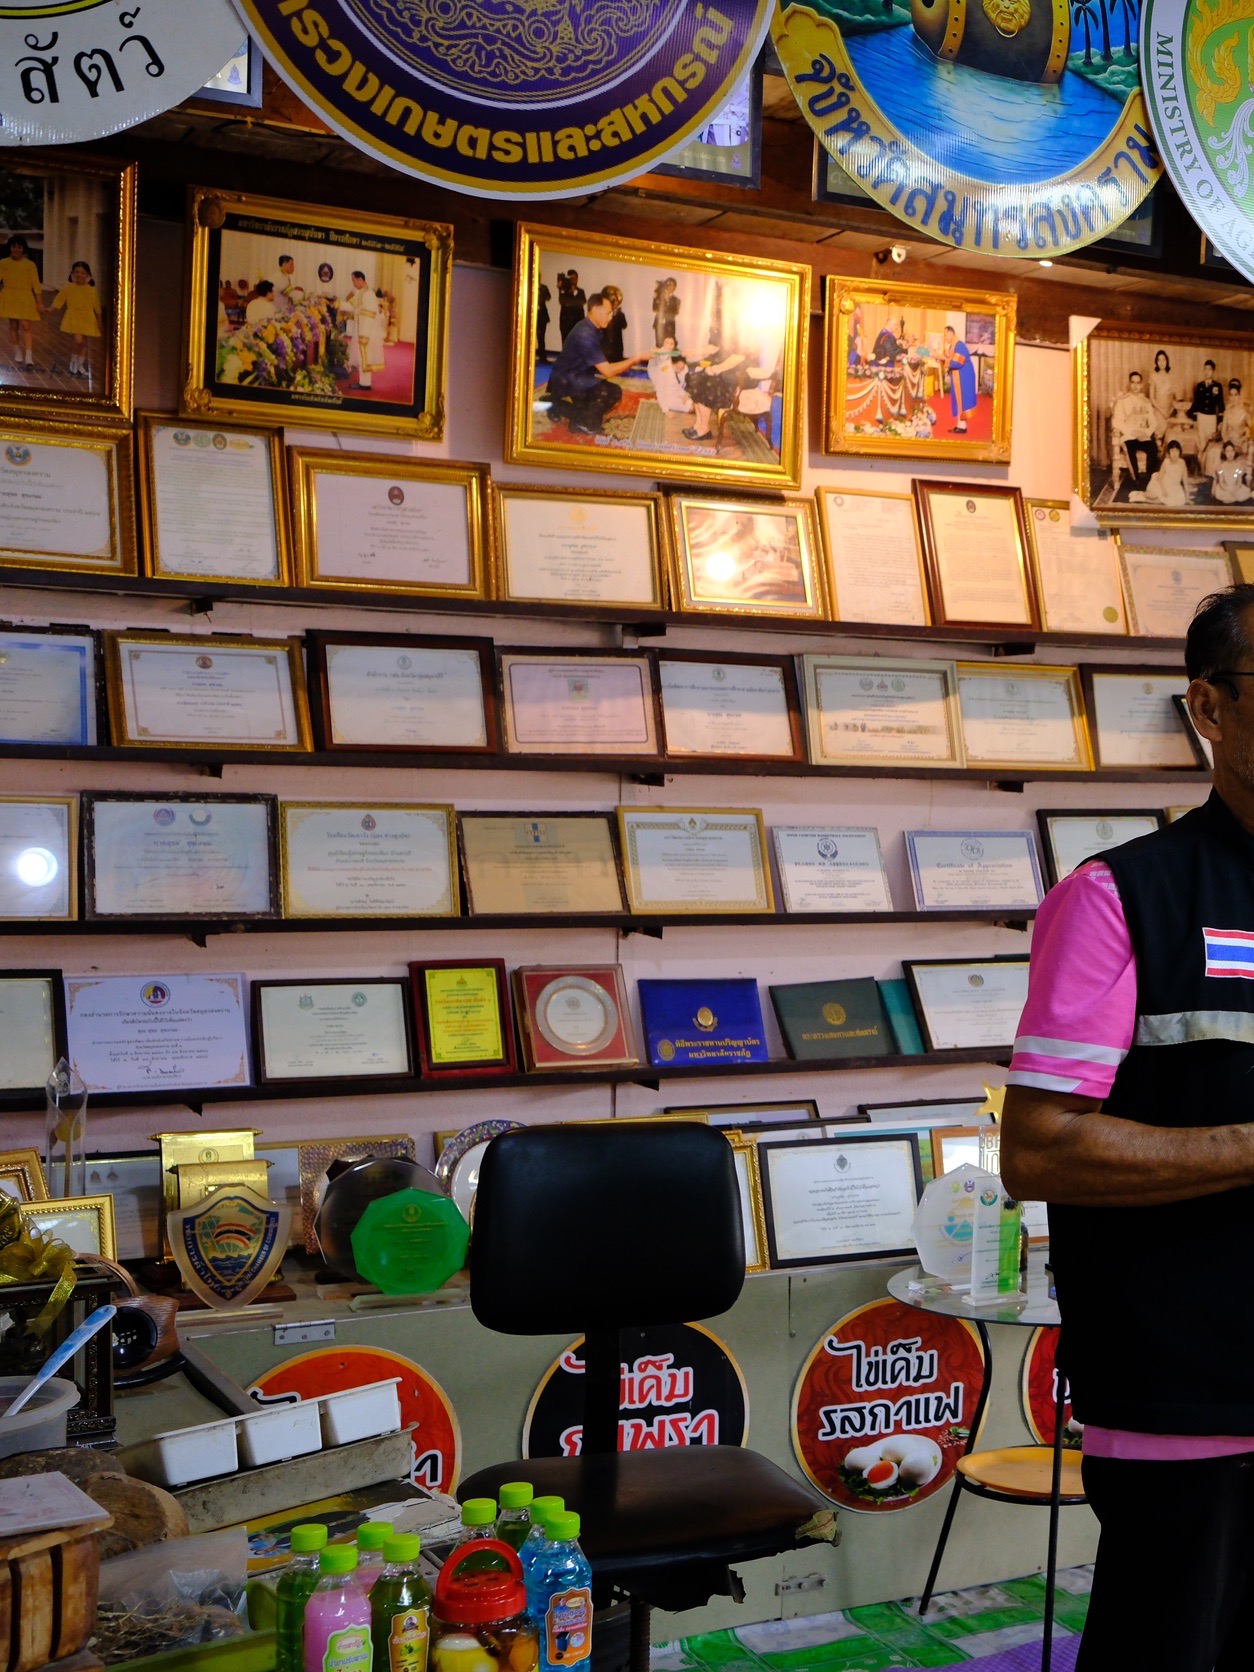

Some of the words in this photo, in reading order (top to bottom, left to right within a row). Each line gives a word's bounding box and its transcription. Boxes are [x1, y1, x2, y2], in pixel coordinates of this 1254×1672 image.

[15, 7, 165, 104] สัตว์
[795, 54, 1158, 250] จังหวัดสมุทรสงคราม
[1156, 31, 1204, 175] MINISTRY
[1196, 178, 1226, 214] OF
[820, 1385, 961, 1438] รสกาแฟ
[827, 1338, 935, 1389] ไข่เค็ม
